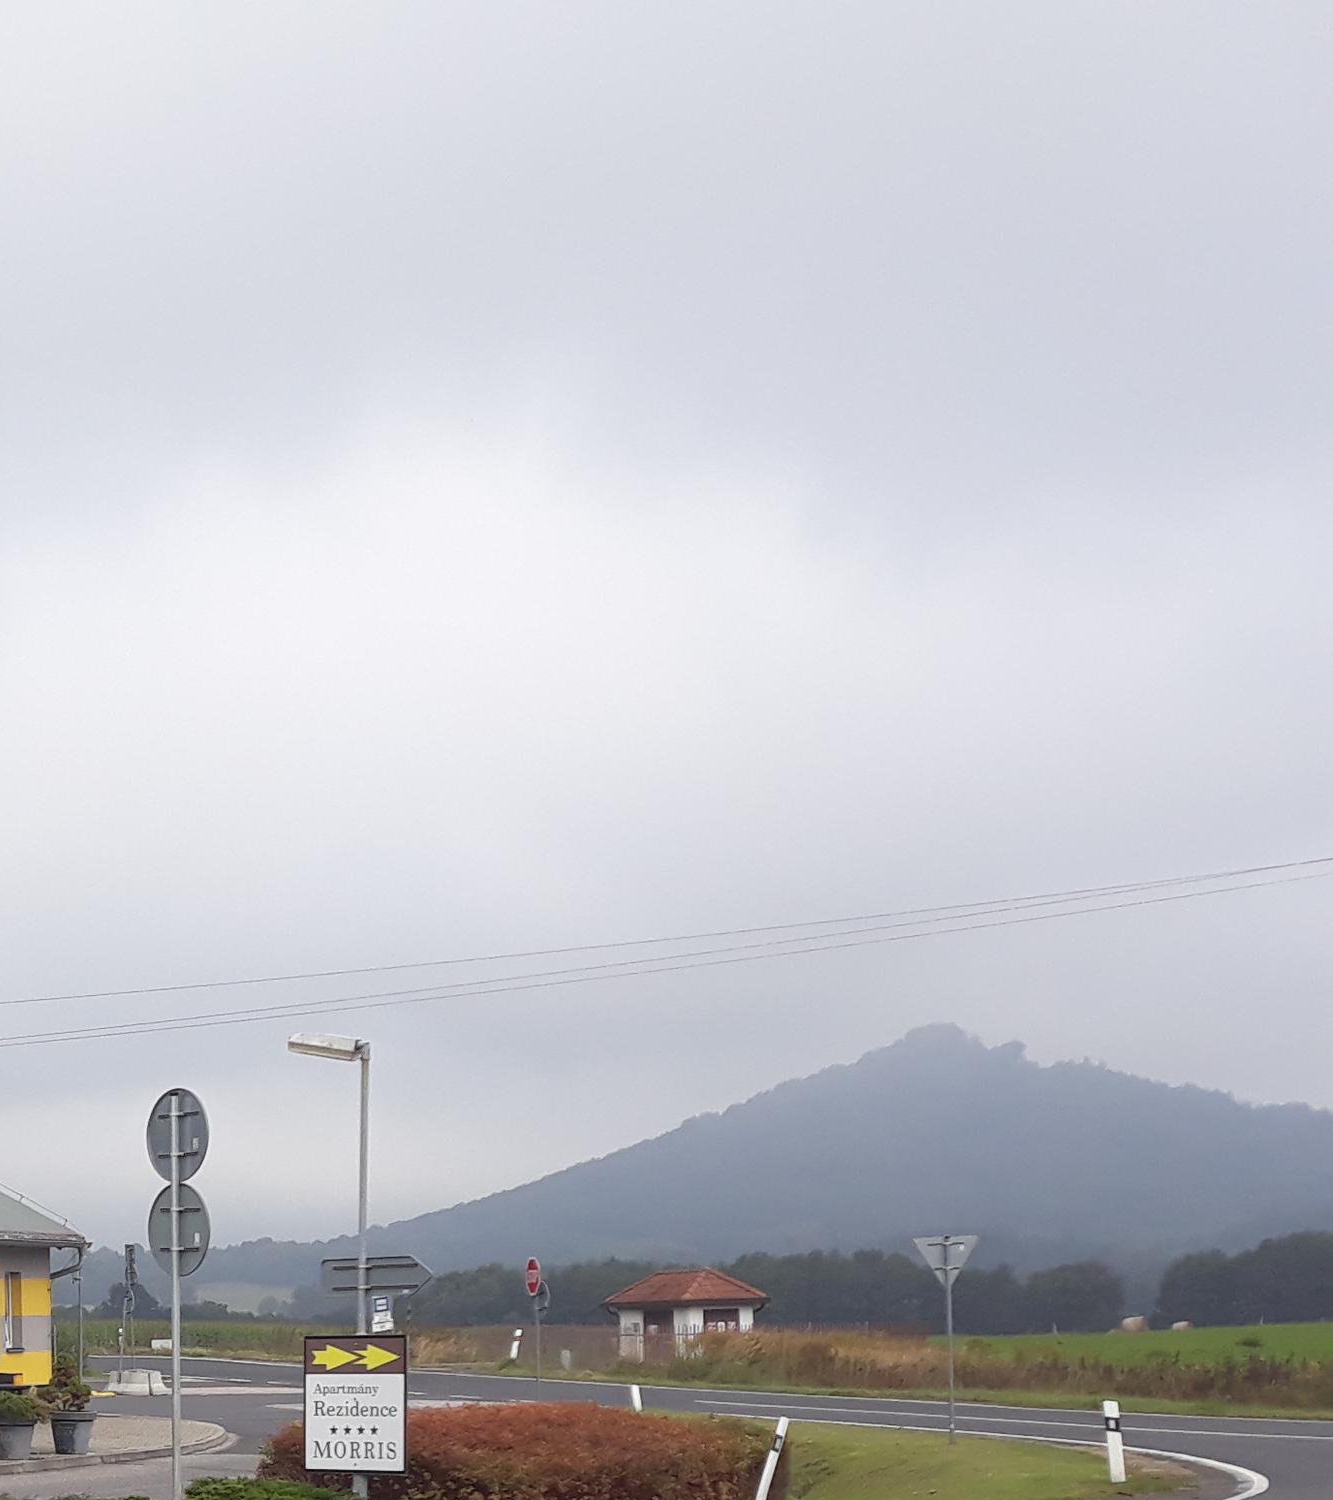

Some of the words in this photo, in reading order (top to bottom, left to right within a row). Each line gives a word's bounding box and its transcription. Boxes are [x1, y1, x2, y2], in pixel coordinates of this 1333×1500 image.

[313, 1383, 379, 1397] Apartmány
[313, 1400, 398, 1418] Rezidence
[313, 1440, 398, 1460] MORRIS
